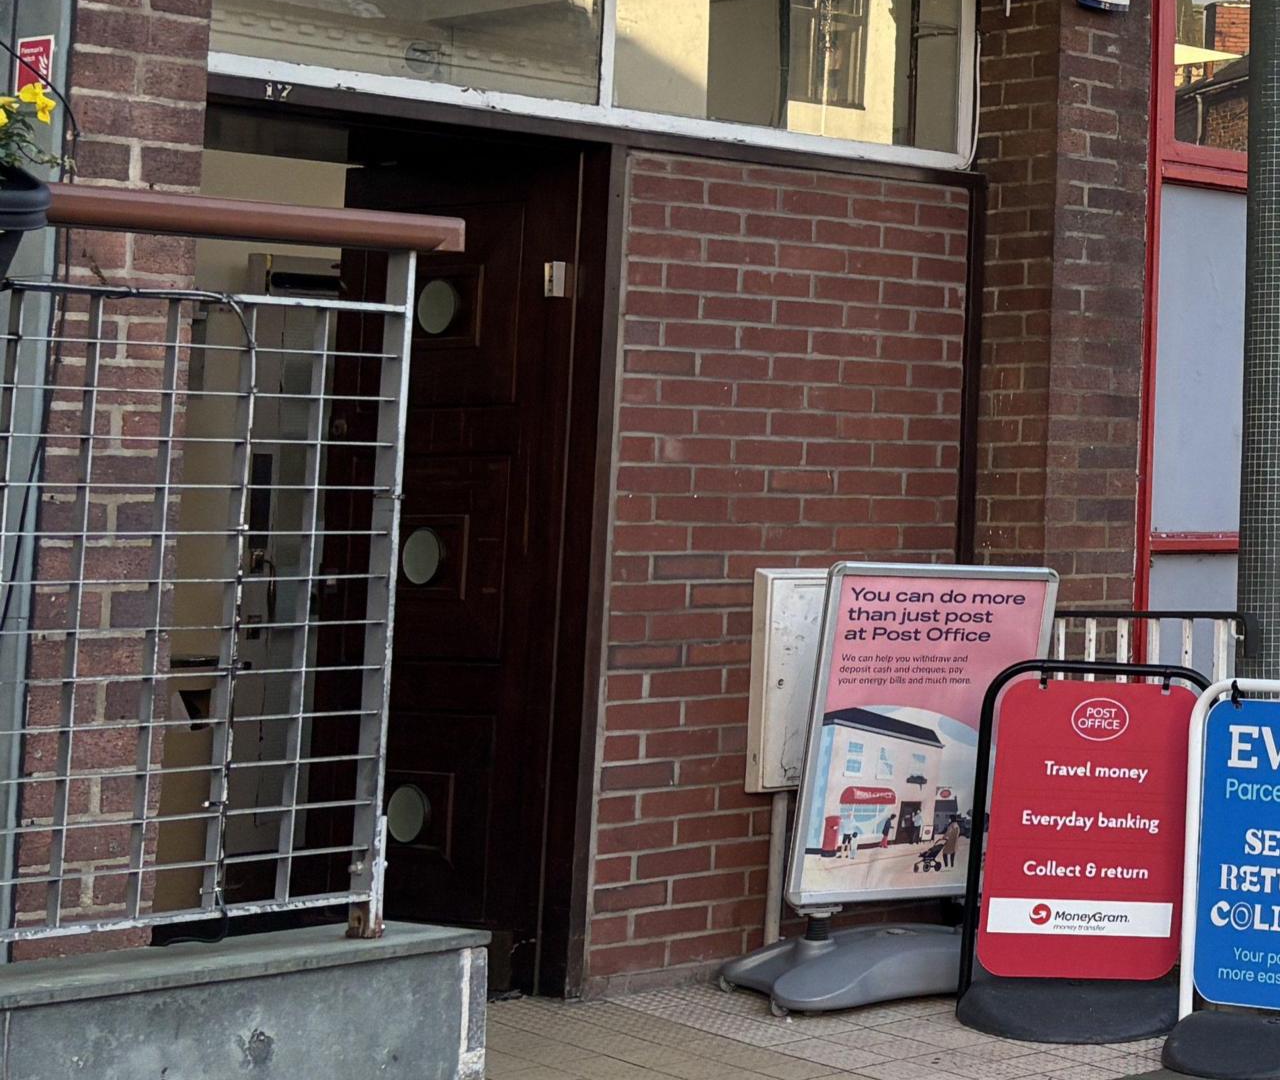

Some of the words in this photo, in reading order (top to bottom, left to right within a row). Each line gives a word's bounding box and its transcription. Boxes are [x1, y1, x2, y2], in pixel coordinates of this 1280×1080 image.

[851, 587, 890, 602] You
[896, 591, 934, 603] can
[940, 590, 966, 604] do
[972, 593, 1026, 605] more
[848, 607, 896, 622] than
[899, 608, 940, 624] just
[945, 610, 993, 625] post
[844, 627, 867, 640] at
[872, 627, 921, 641] Post
[926, 627, 991, 642] Office
[841, 654, 856, 662] We
[875, 654, 894, 664] help
[895, 656, 911, 664] you
[912, 654, 951, 663] withdraw
[952, 654, 968, 663] and
[839, 665, 871, 675] deposit
[949, 667, 964, 675] pay
[838, 677, 857, 686] your
[859, 677, 887, 686] energy
[889, 676, 906, 685] bills
[908, 676, 923, 685] and
[925, 676, 948, 685] much
[1086, 707, 1117, 718] POST
[1078, 719, 1120, 730] OFFICE
[1045, 760, 1091, 777] Travel
[1095, 767, 1148, 783] money
[1022, 810, 1094, 831] Everyday
[1098, 812, 1160, 834] banking
[1023, 860, 1081, 877] Collect
[1085, 863, 1096, 877] &
[1101, 866, 1148, 879] return
[1233, 946, 1264, 963] Your
[1218, 968, 1254, 981] more
